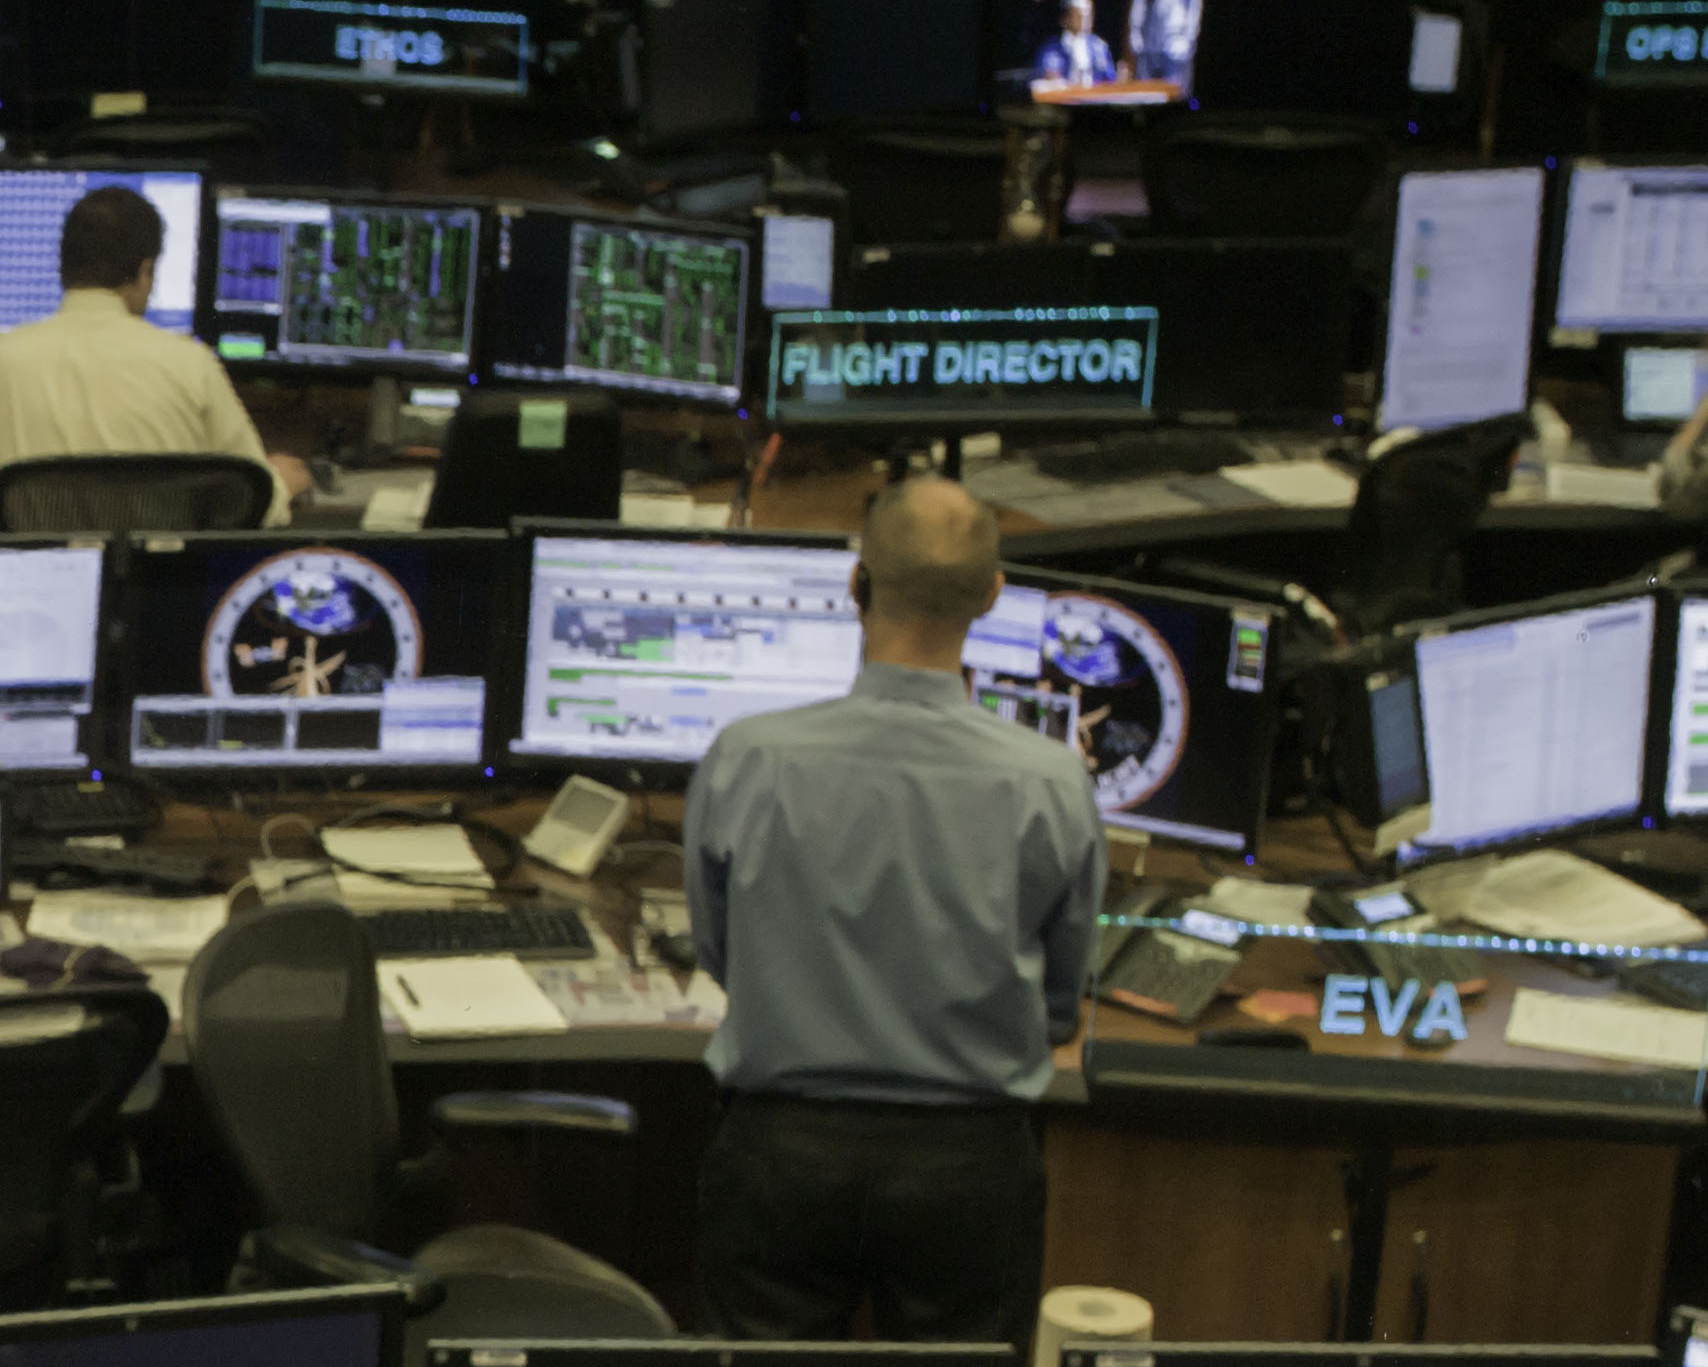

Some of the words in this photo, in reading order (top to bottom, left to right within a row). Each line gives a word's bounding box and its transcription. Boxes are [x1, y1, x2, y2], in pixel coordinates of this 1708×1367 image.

[783, 343, 928, 385] FLIGHT
[935, 340, 1142, 384] DIRECTOR
[1319, 975, 1467, 1040] EVA
